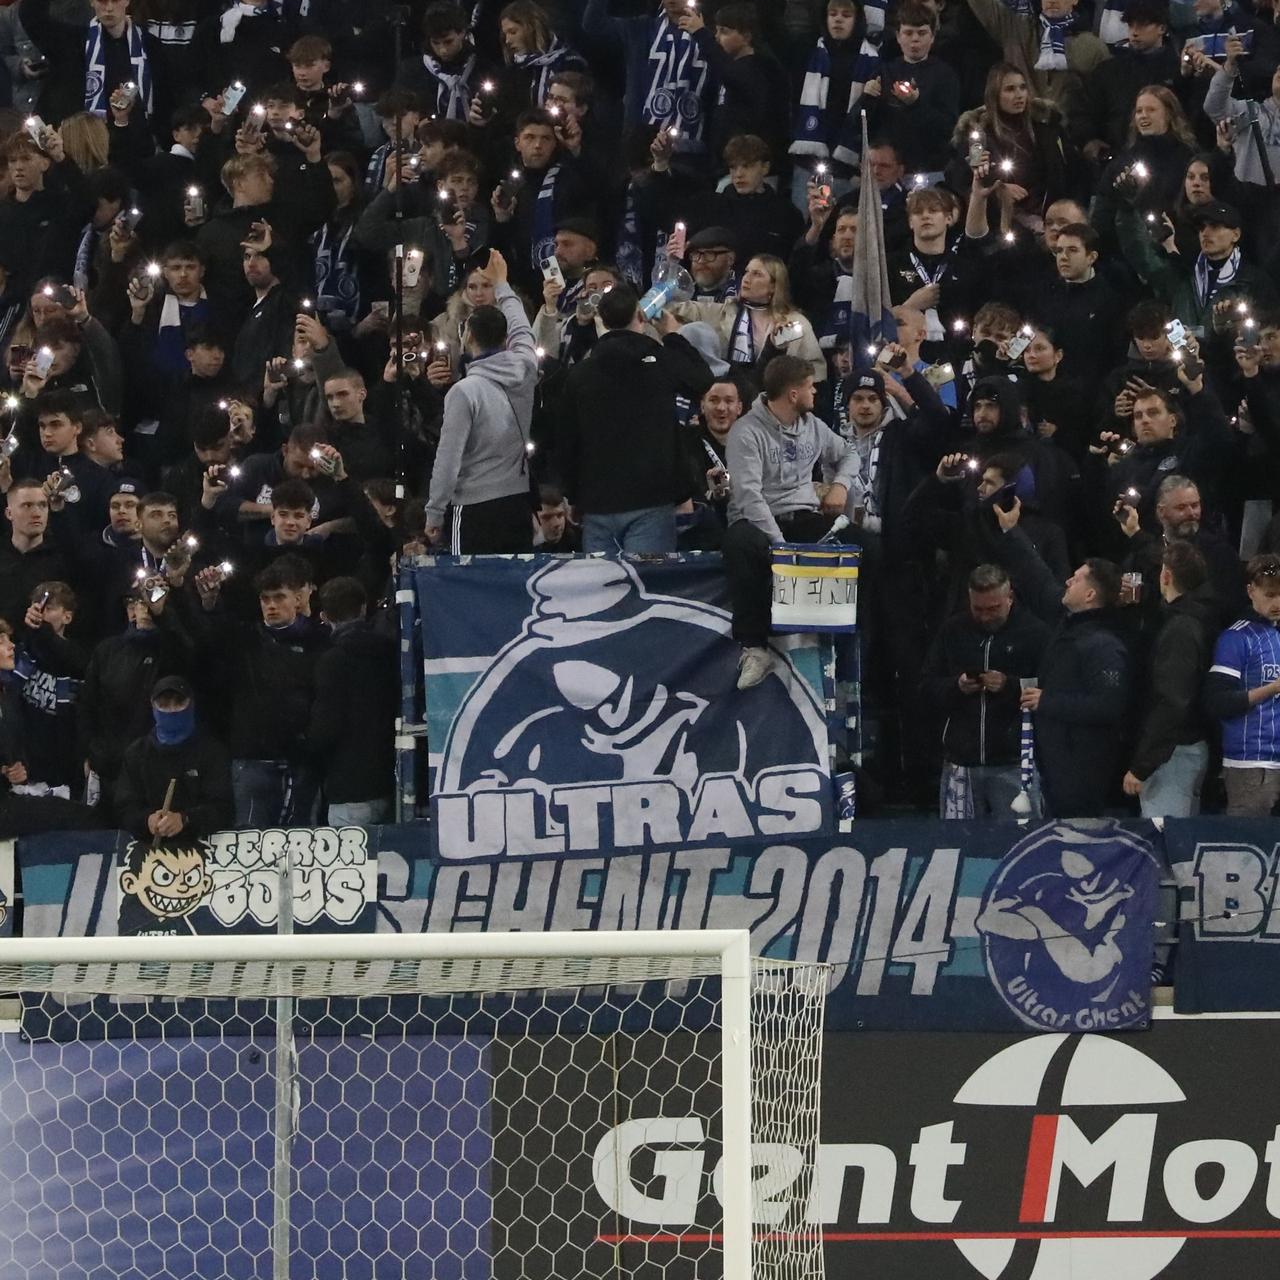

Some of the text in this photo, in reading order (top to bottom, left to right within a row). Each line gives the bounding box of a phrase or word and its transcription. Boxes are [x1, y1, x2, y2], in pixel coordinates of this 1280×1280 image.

[209, 827, 368, 868] TERROR
[437, 770, 822, 859] ULTRAS
[208, 866, 366, 927] BOYS
[420, 848, 731, 998] GHENT
[746, 846, 961, 996] 2014
[1008, 976, 1147, 1029] Ultras Ghent
[593, 1117, 967, 1226] Gent
